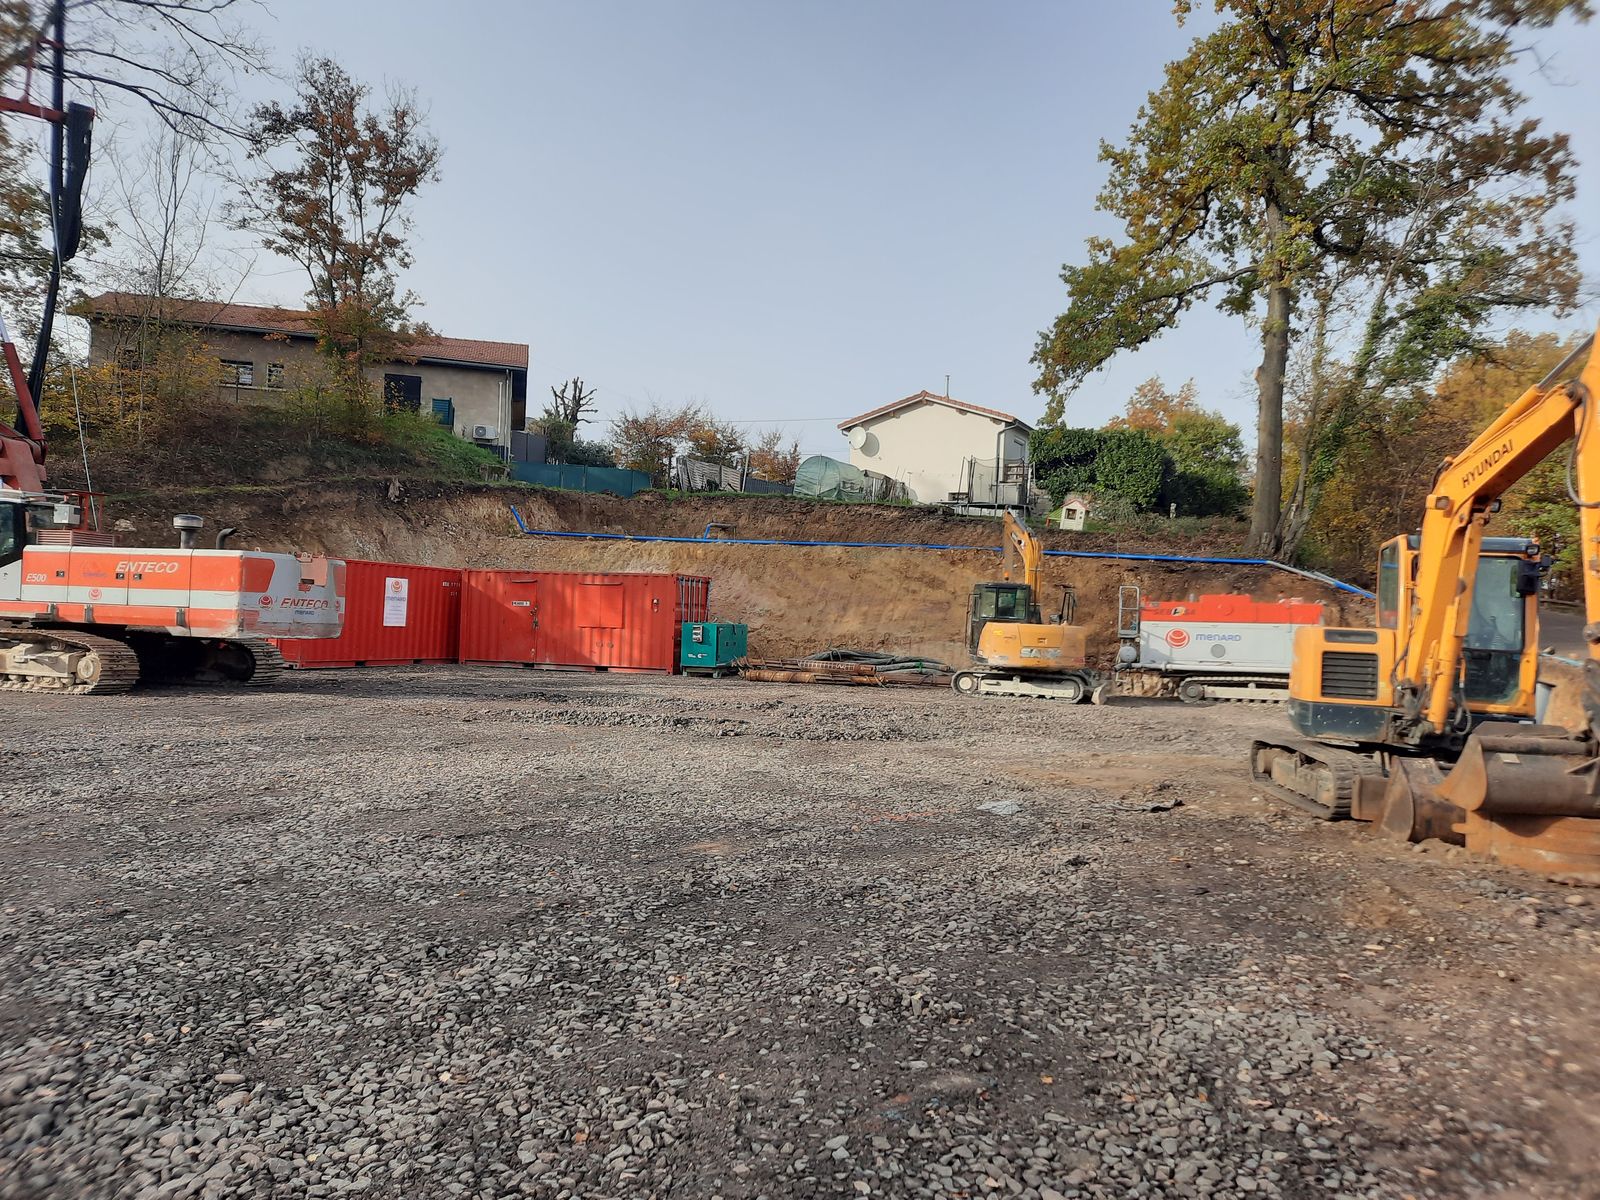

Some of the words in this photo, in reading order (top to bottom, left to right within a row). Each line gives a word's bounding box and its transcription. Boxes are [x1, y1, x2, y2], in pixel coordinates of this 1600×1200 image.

[1462, 439, 1513, 488] HYUNDAI
[115, 561, 179, 574] ENTECO
[25, 573, 47, 582] E500
[280, 598, 329, 610] ENTECO
